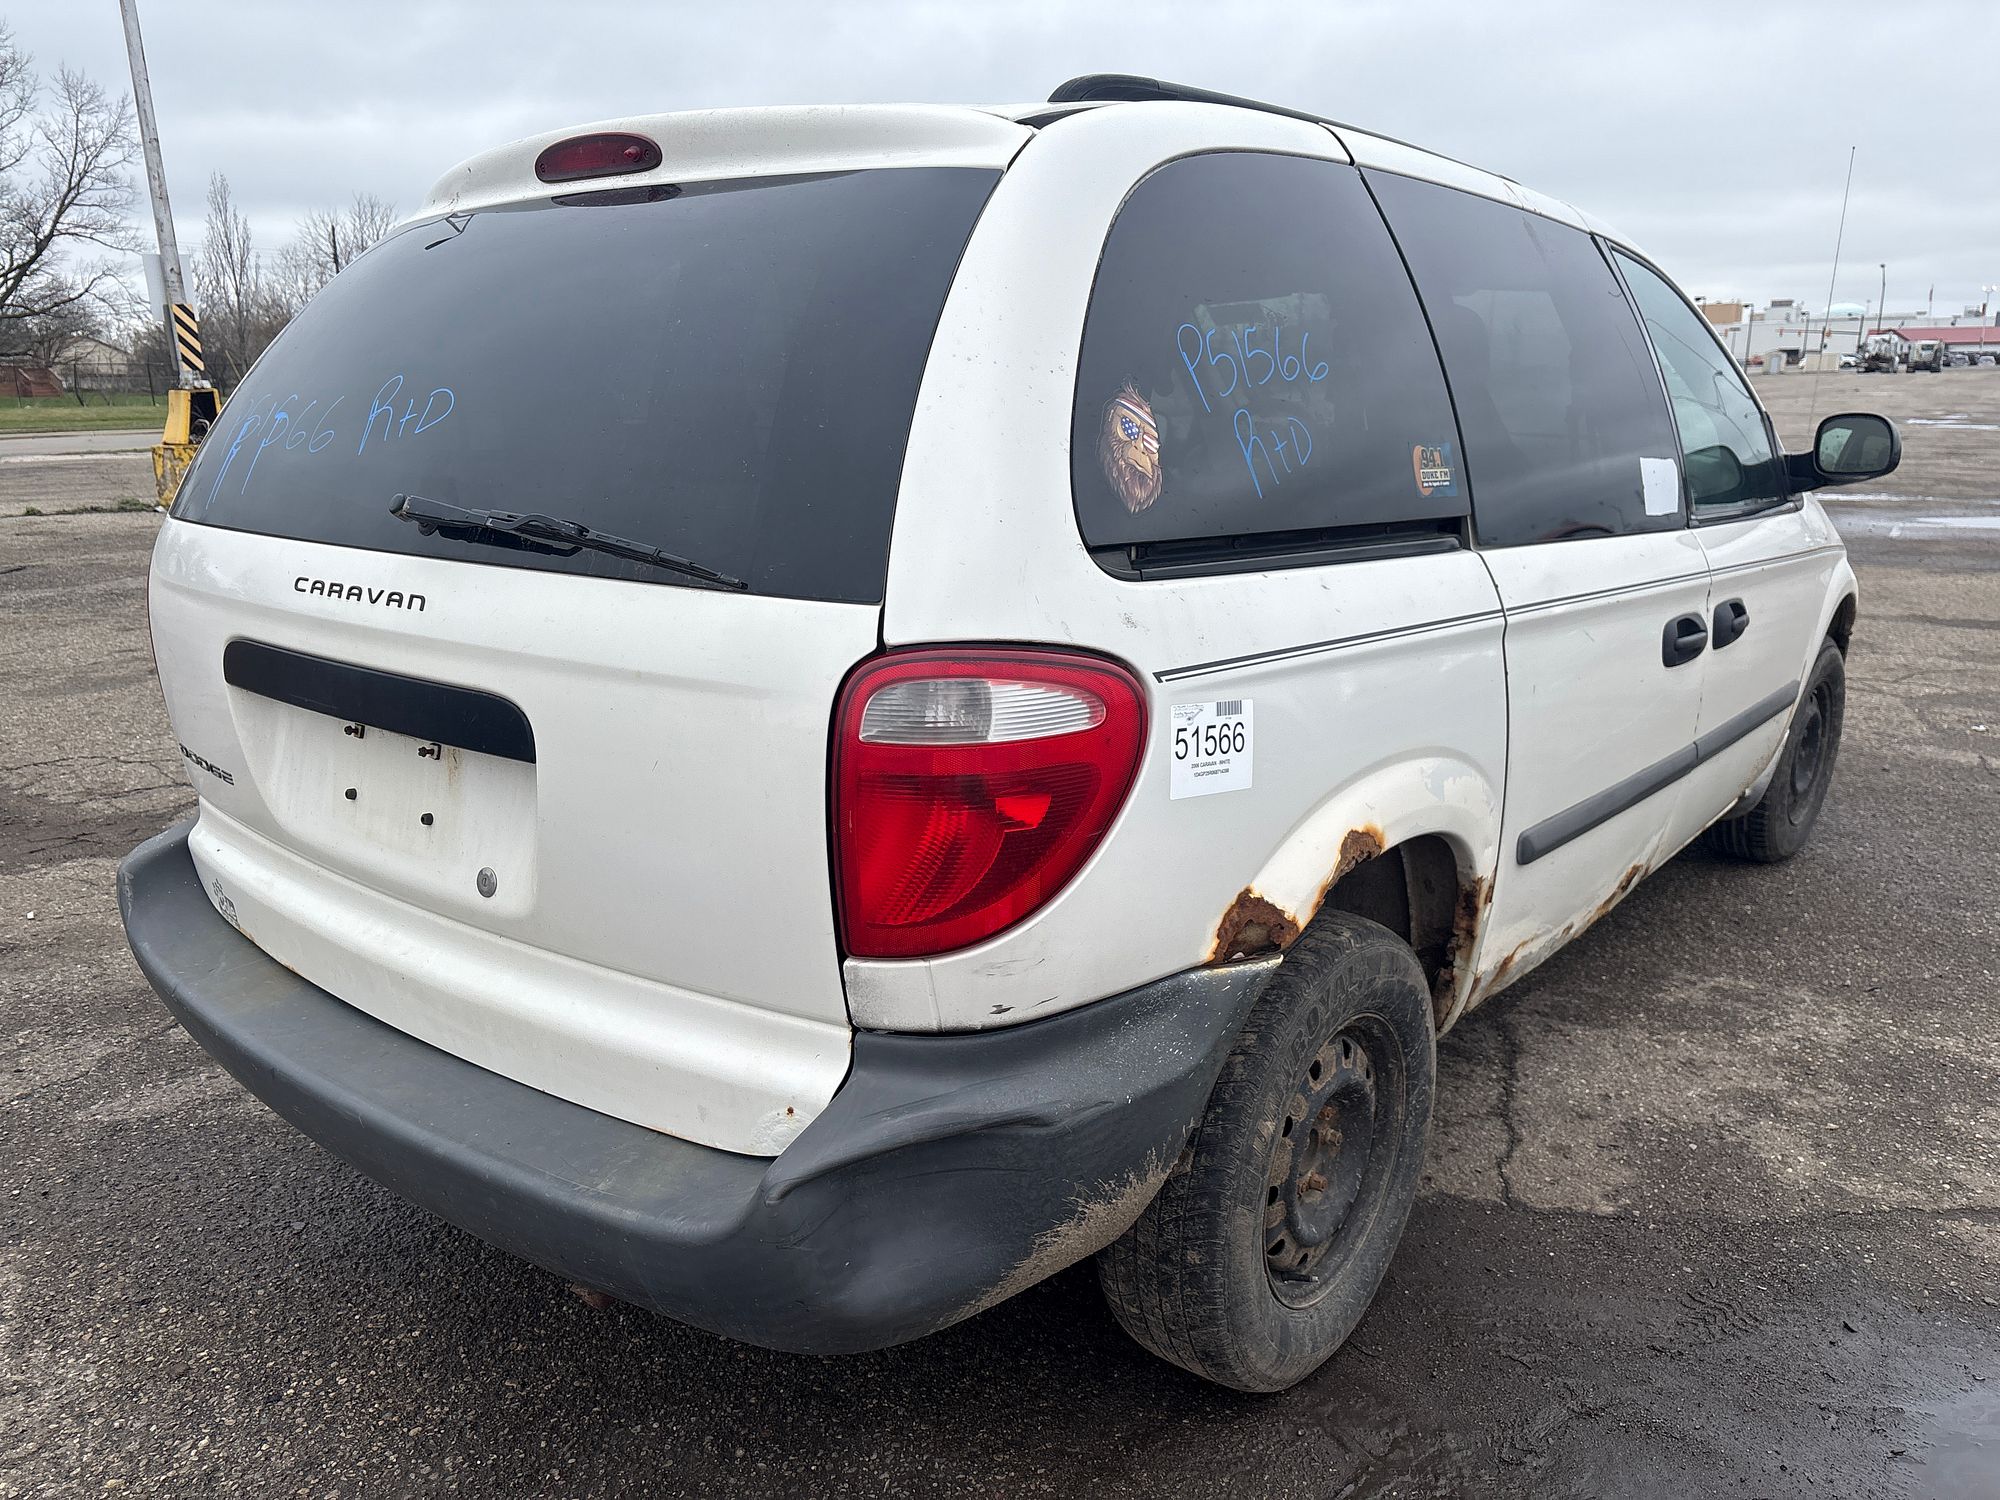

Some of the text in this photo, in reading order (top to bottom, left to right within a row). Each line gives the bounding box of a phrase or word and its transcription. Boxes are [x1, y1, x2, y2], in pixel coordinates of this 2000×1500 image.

[1177, 323, 1330, 413] P51566
[1420, 446, 1445, 468] 94.1
[1421, 470, 1450, 480] DUKE FM
[294, 576, 426, 612] CARAVAN
[1175, 722, 1245, 760] 51566
[179, 743, 235, 786] DODGE
